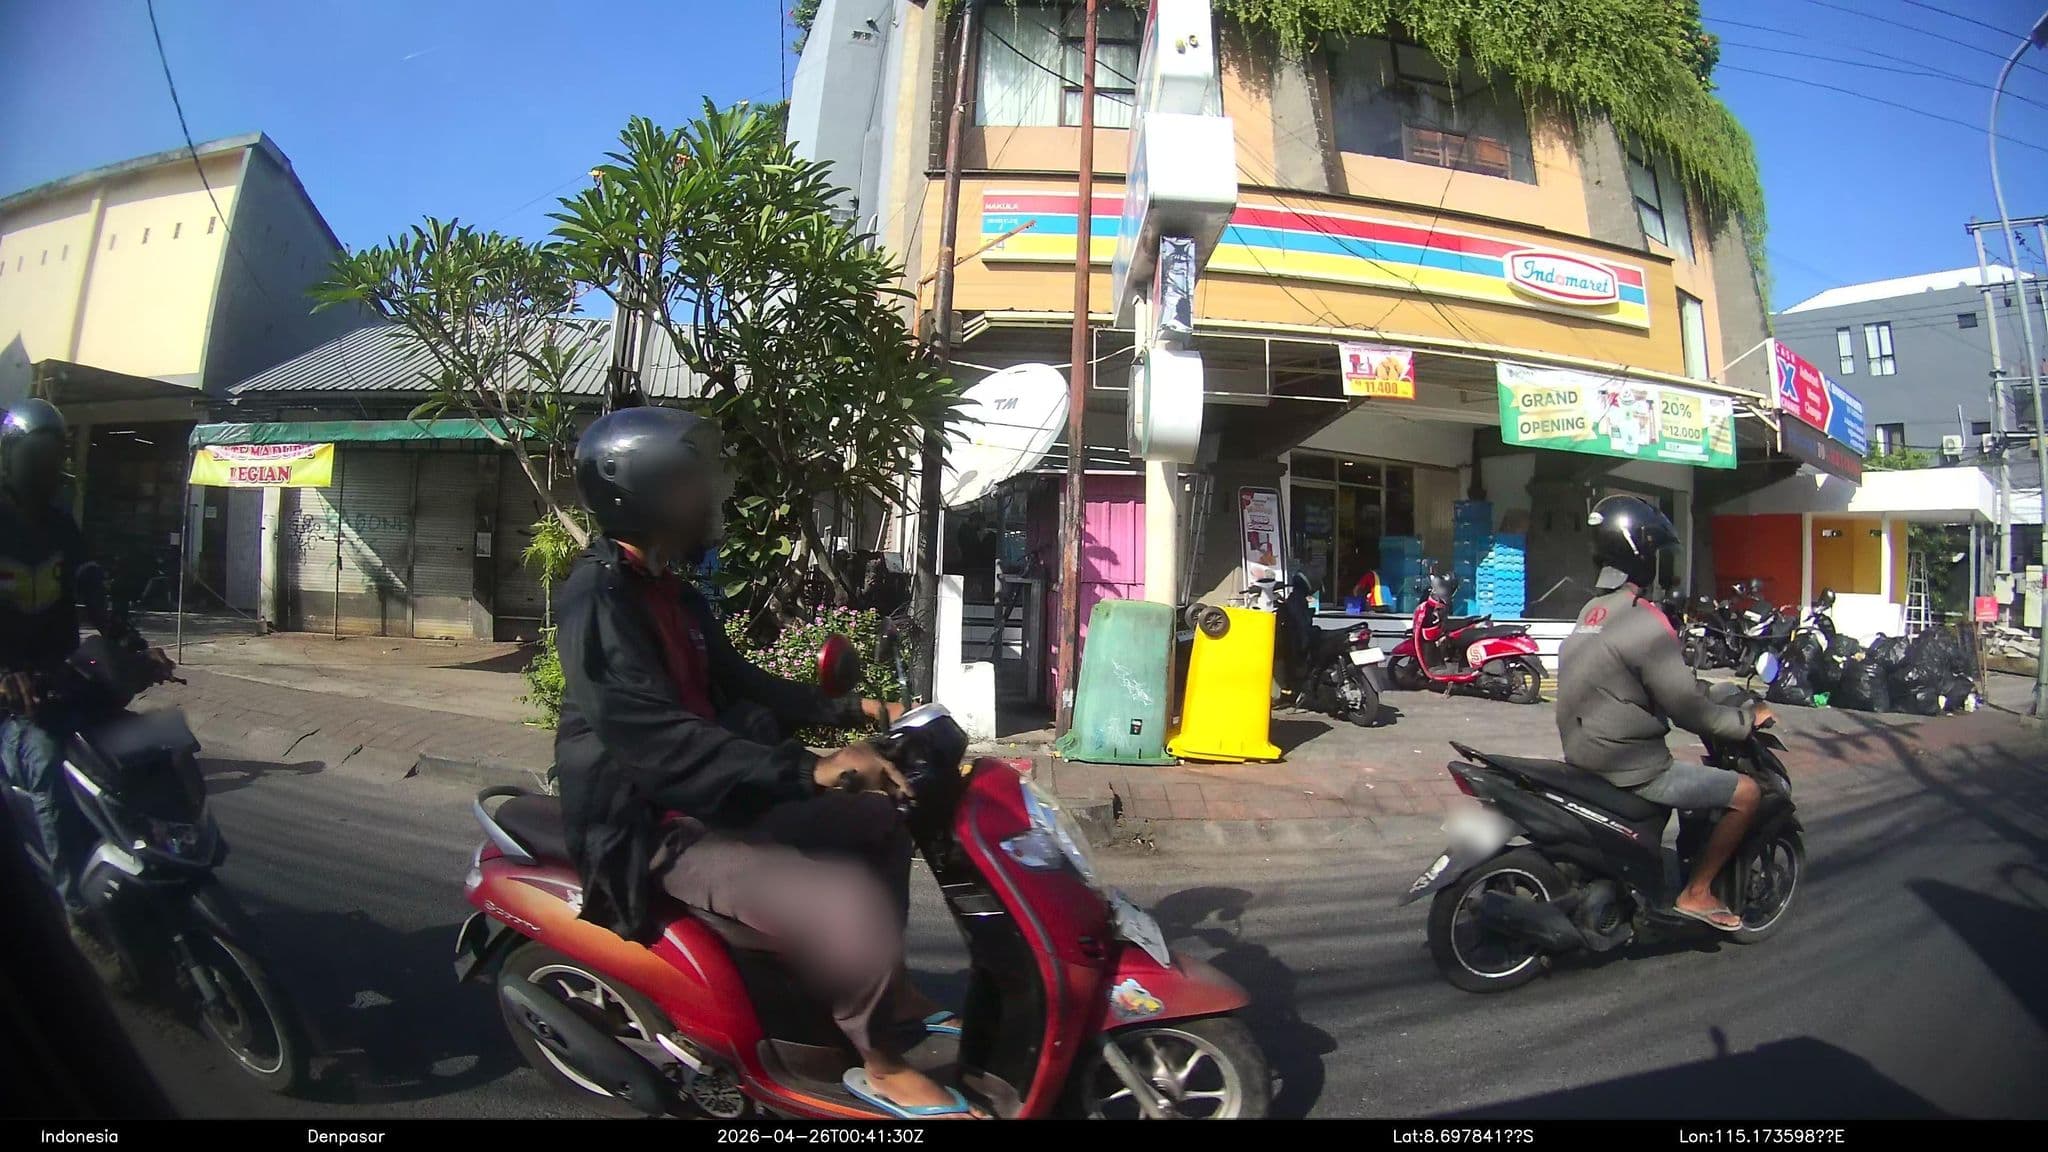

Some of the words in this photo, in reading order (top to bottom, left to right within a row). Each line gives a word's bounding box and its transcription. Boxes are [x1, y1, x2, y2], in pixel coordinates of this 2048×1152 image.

[1521, 260, 1608, 293] Indomaret
[994, 398, 1019, 411] TM
[1521, 391, 1578, 408] GRAND
[1661, 400, 1692, 419] 20%
[1520, 417, 1585, 435] OPENING
[230, 465, 291, 484] LEGIAN
